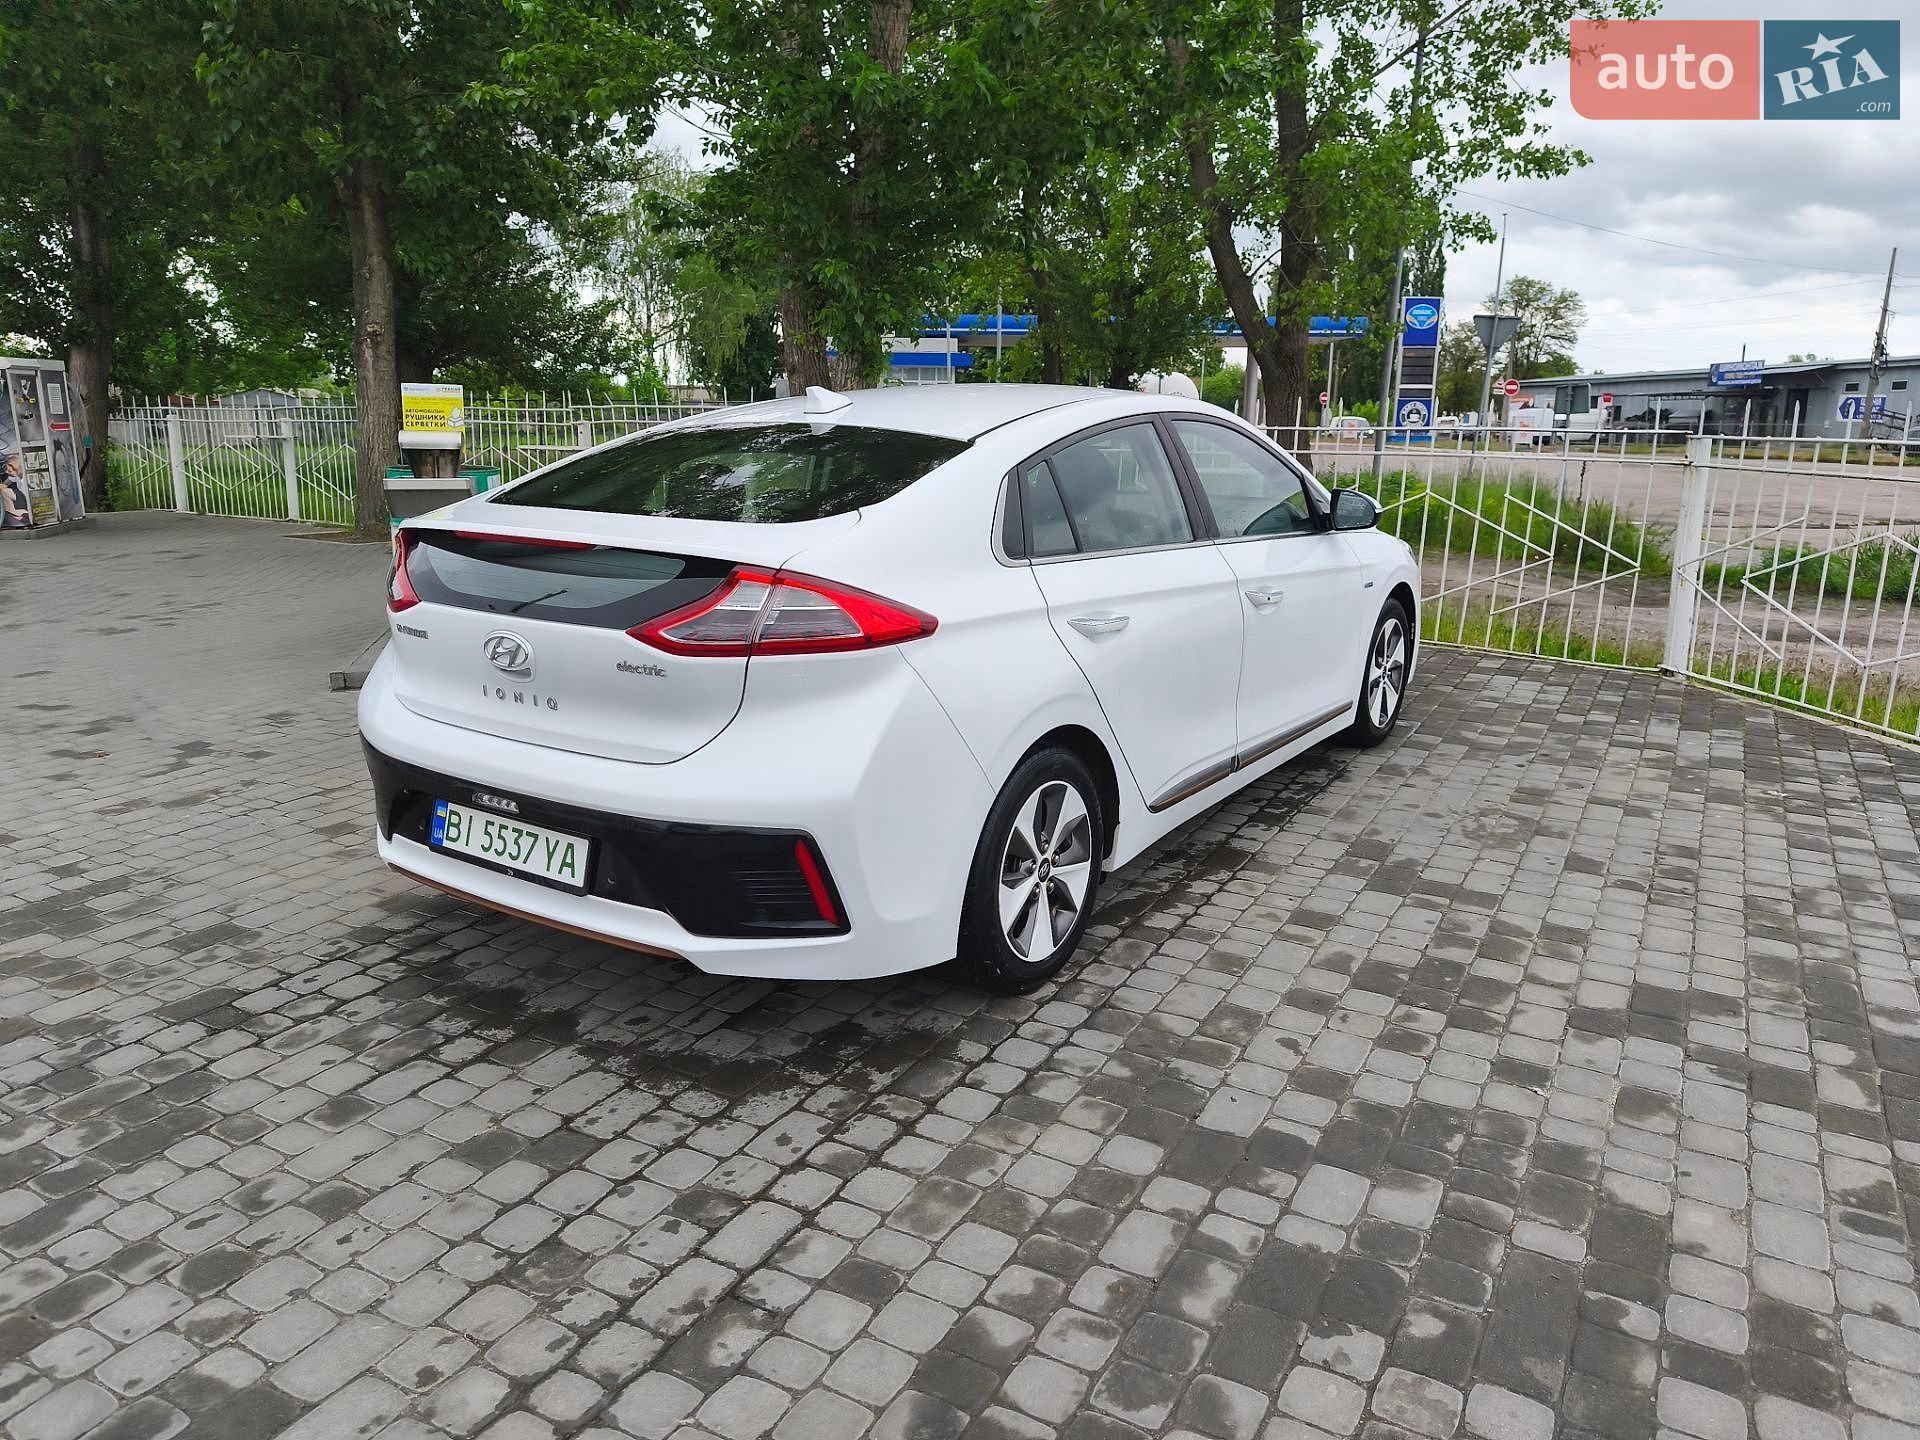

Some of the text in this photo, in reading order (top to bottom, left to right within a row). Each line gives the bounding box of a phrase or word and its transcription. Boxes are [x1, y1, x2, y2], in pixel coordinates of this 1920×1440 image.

[616, 660, 667, 678] electric
[482, 684, 559, 711] IONIQ
[433, 827, 444, 840] UA
[445, 809, 576, 879] BI 5537 YA
